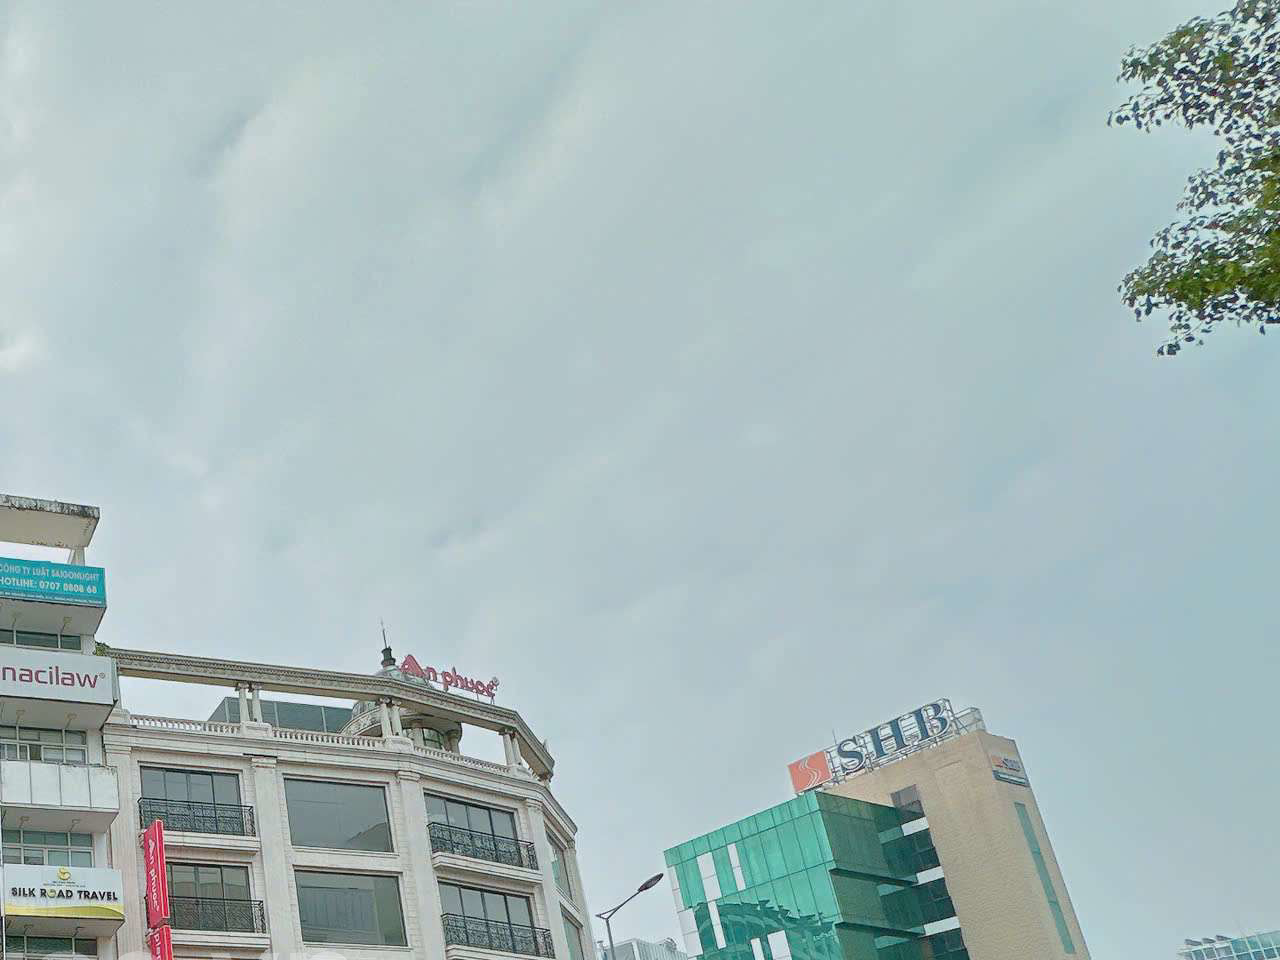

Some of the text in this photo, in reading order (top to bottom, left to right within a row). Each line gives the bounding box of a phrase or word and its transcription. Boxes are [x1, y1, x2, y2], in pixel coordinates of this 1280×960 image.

[836, 703, 952, 775] SHB
[11, 887, 119, 901] SILK ROAD TRAVEL
